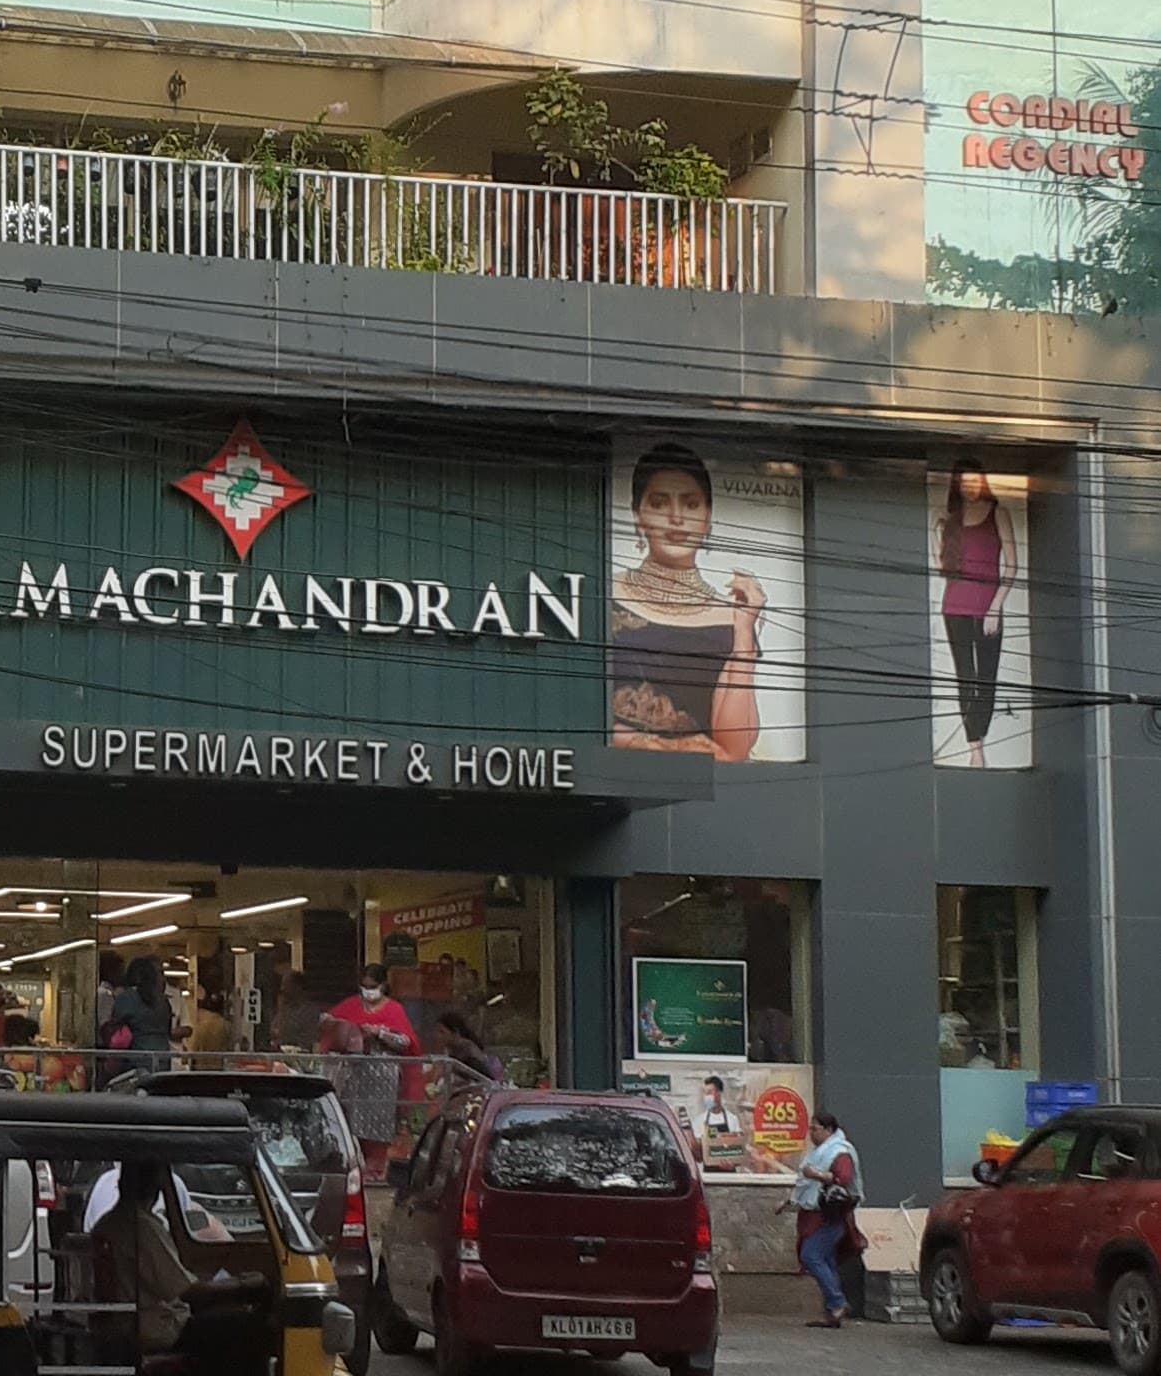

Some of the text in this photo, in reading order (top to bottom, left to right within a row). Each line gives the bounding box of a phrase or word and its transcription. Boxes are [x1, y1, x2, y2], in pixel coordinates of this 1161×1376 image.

[967, 91, 1138, 136] CORDIAL
[962, 134, 1144, 180] REGENCY
[723, 479, 801, 498] VIVARNA
[41, 724, 575, 789] SUPERMARKET & HOME
[393, 899, 474, 925] CELEBRATE
[763, 1101, 797, 1122] 365
